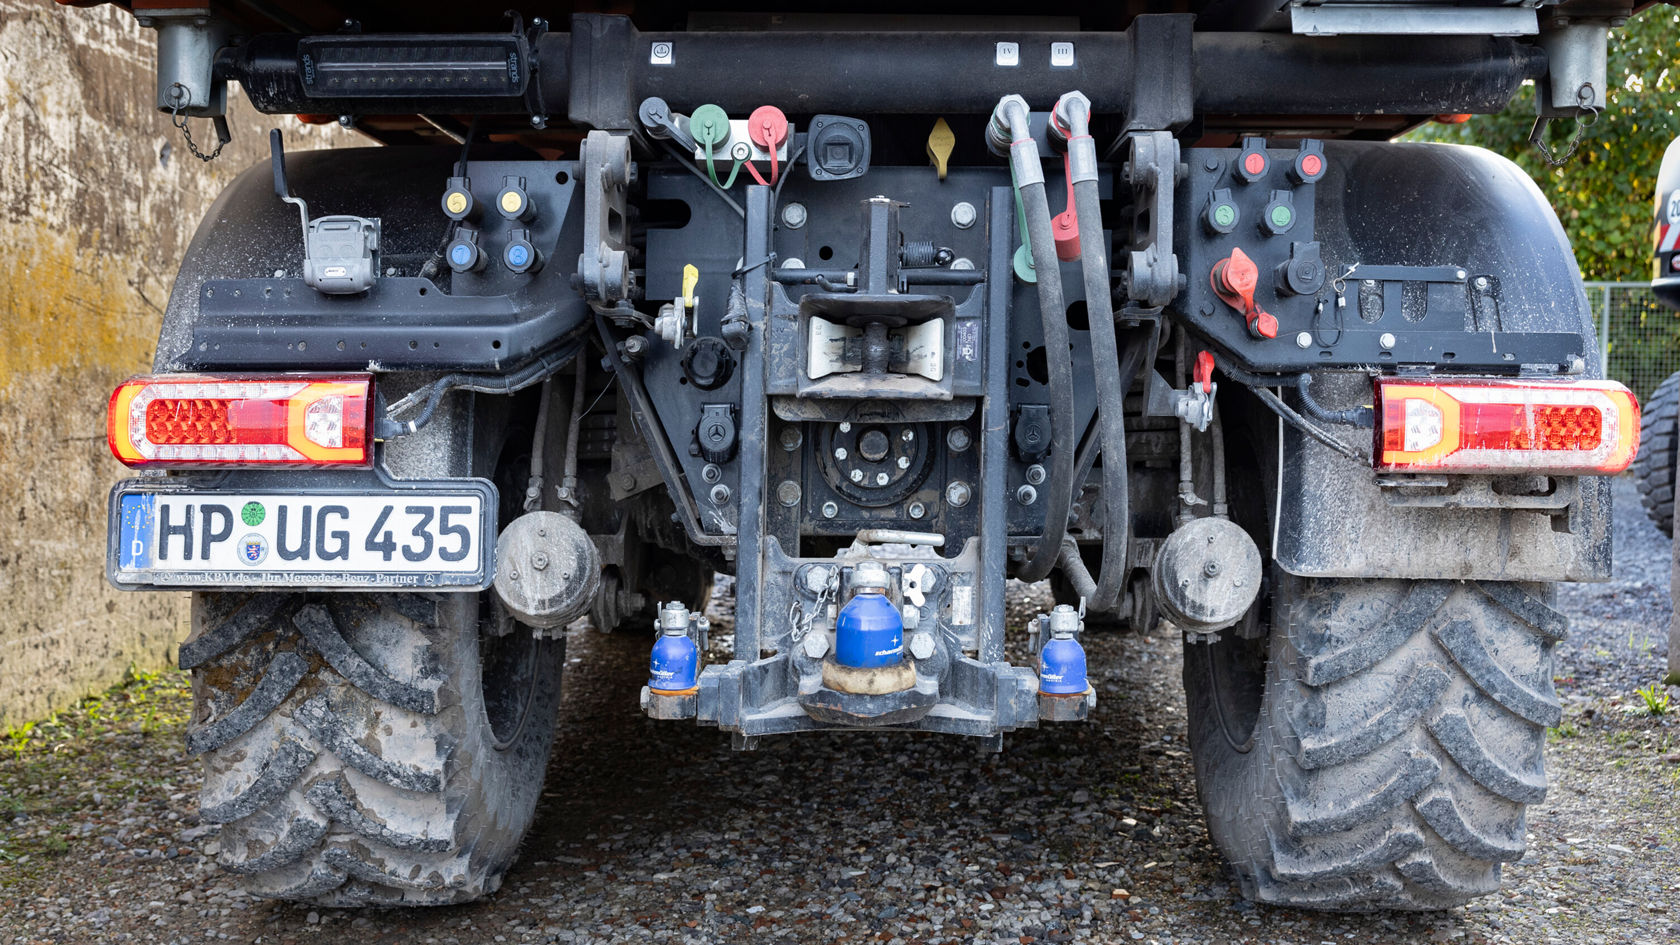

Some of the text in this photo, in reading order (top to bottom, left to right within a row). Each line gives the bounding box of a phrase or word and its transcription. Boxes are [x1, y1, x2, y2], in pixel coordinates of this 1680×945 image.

[303, 54, 313, 84] strands
[510, 52, 519, 82] strands
[131, 540, 144, 556] D
[158, 504, 234, 561] HP
[276, 504, 350, 561] UG
[365, 504, 473, 562] 435
[283, 573, 419, 584] Mercedes-Benz-Partner
